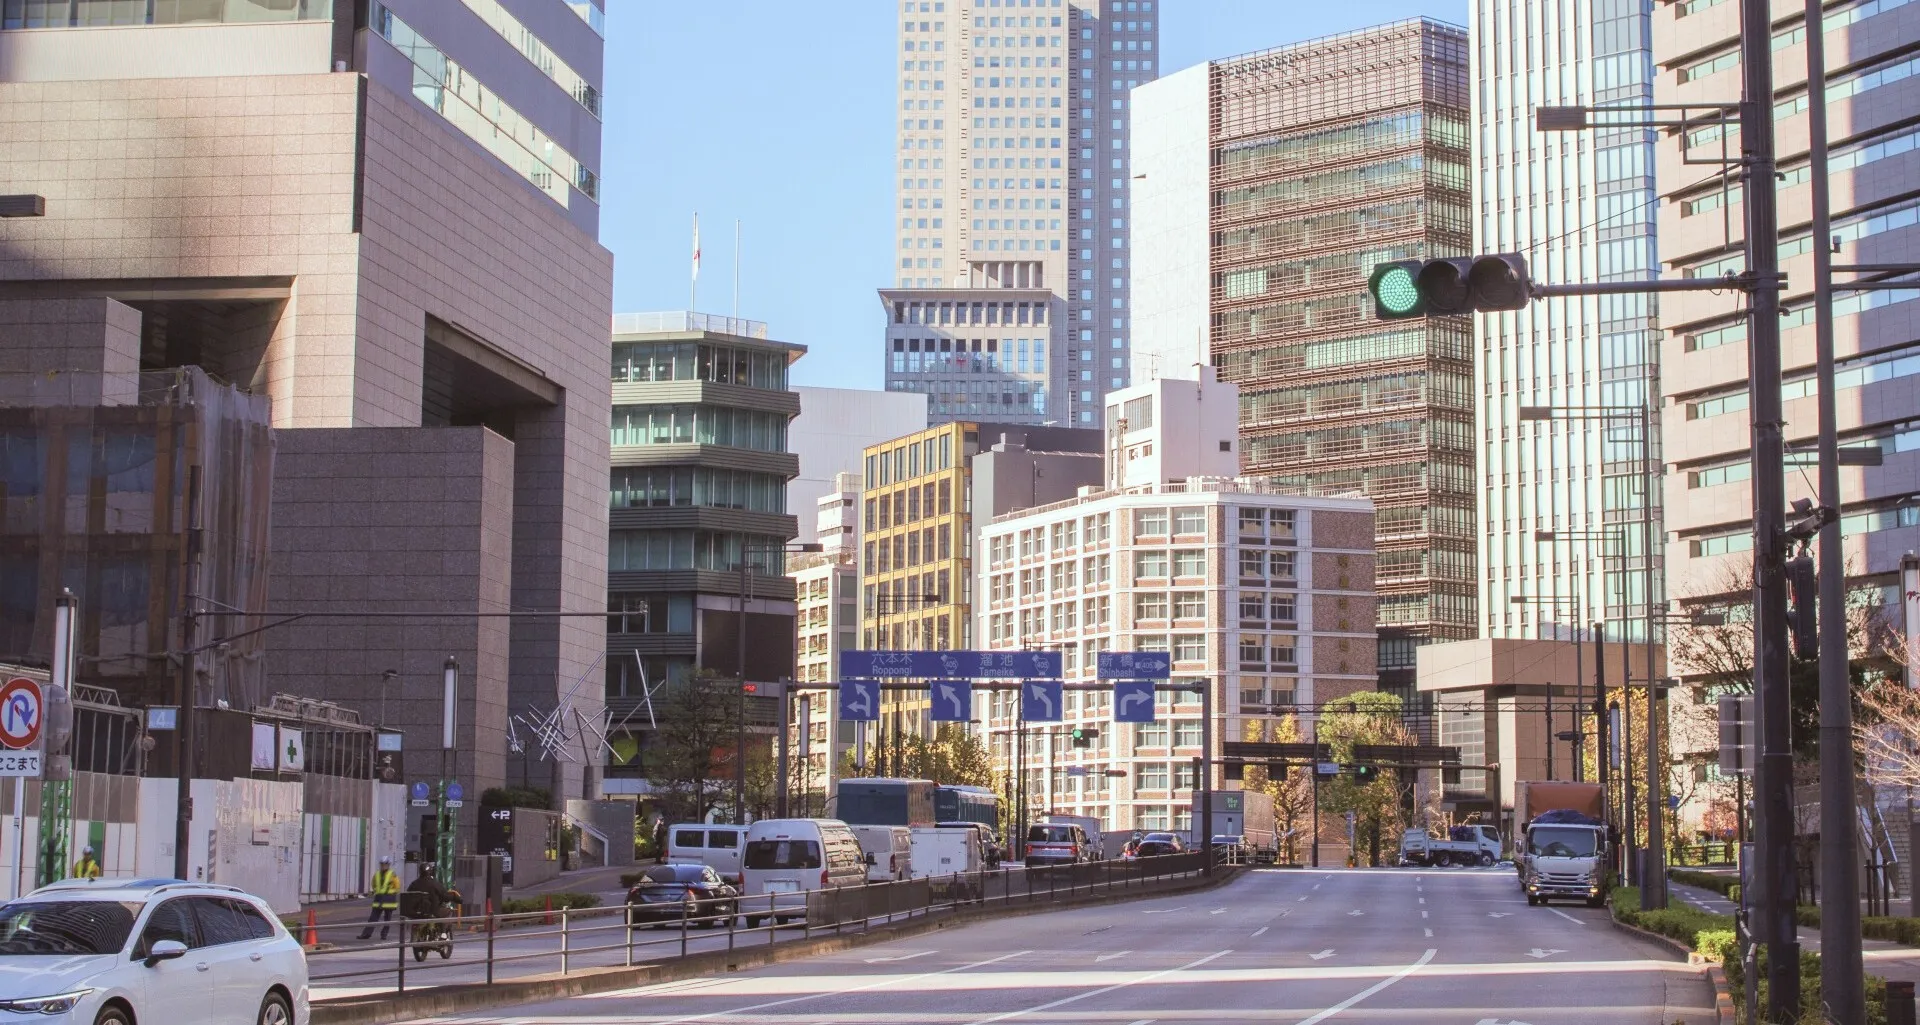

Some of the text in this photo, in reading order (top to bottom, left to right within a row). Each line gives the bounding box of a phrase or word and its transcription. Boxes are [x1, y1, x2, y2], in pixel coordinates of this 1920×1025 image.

[871, 652, 913, 665] 六本木
[1100, 654, 1134, 667] 新橋
[945, 661, 958, 669] 405
[1037, 661, 1048, 669] 405
[1141, 661, 1153, 669] 405
[872, 665, 912, 677] Roppongi
[978, 667, 1015, 677] Tameike
[1100, 668, 1135, 678] Shinbashi
[156, 711, 165, 728] 4
[500, 810, 510, 820] P
